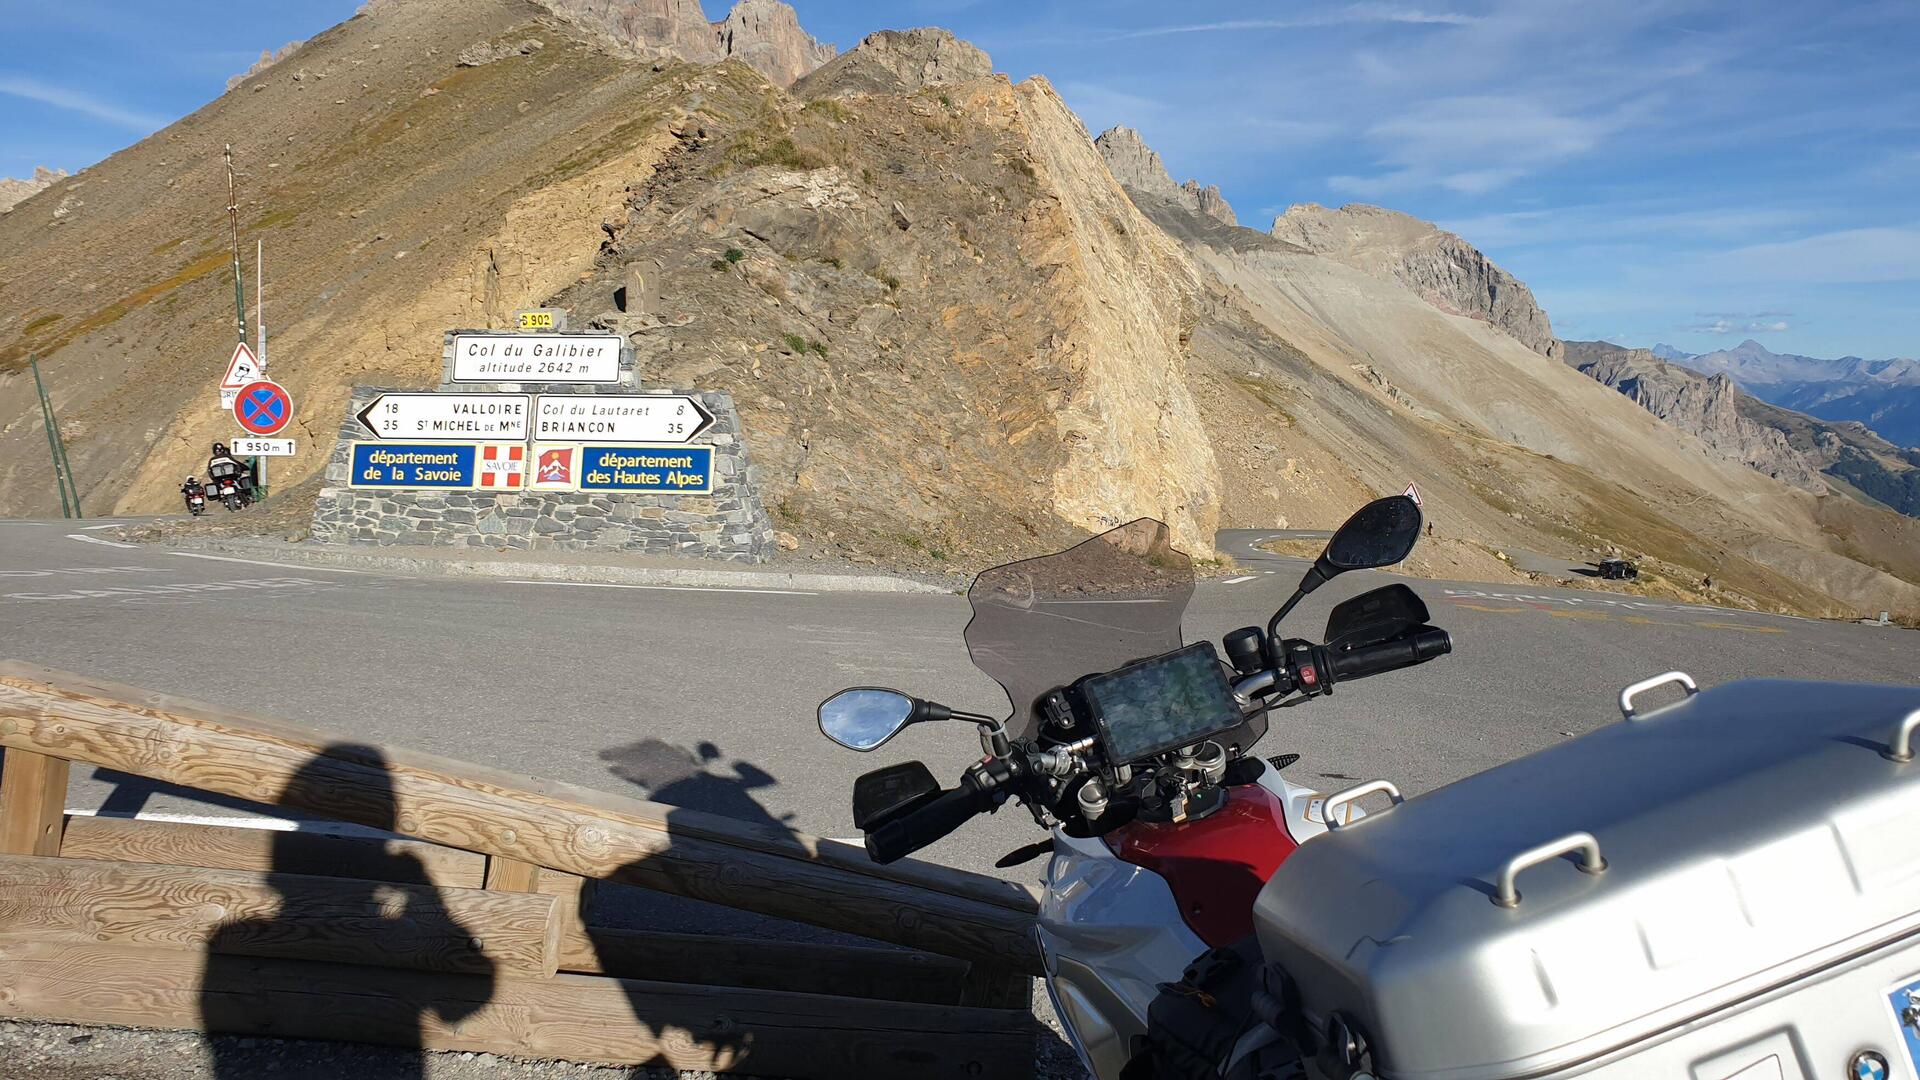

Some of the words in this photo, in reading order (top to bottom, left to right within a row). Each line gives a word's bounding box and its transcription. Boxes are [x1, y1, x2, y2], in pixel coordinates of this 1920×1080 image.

[531, 315, 550, 326] 902
[468, 344, 494, 357] Col
[505, 344, 523, 357] du
[533, 344, 603, 358] Galibier
[479, 363, 532, 373] altitude
[538, 363, 573, 374] 2642
[578, 366, 589, 374] m
[385, 403, 399, 414] 18
[453, 404, 522, 415] VALLOIRE
[543, 404, 564, 416] Col
[570, 404, 585, 416] du
[592, 405, 650, 417] Lautaret
[676, 405, 685, 416] 8
[383, 420, 399, 431] 35
[432, 421, 481, 431] MICHEL
[667, 423, 684, 434] 35
[246, 442, 270, 452] 950
[369, 450, 458, 467] département
[599, 453, 692, 470] département
[486, 461, 518, 471] SAVOIE
[364, 466, 382, 480] de
[392, 467, 405, 480] la
[415, 467, 462, 482] Savoie
[586, 469, 611, 484] des
[614, 470, 661, 485] Hautes
[665, 470, 704, 488] Alpes
